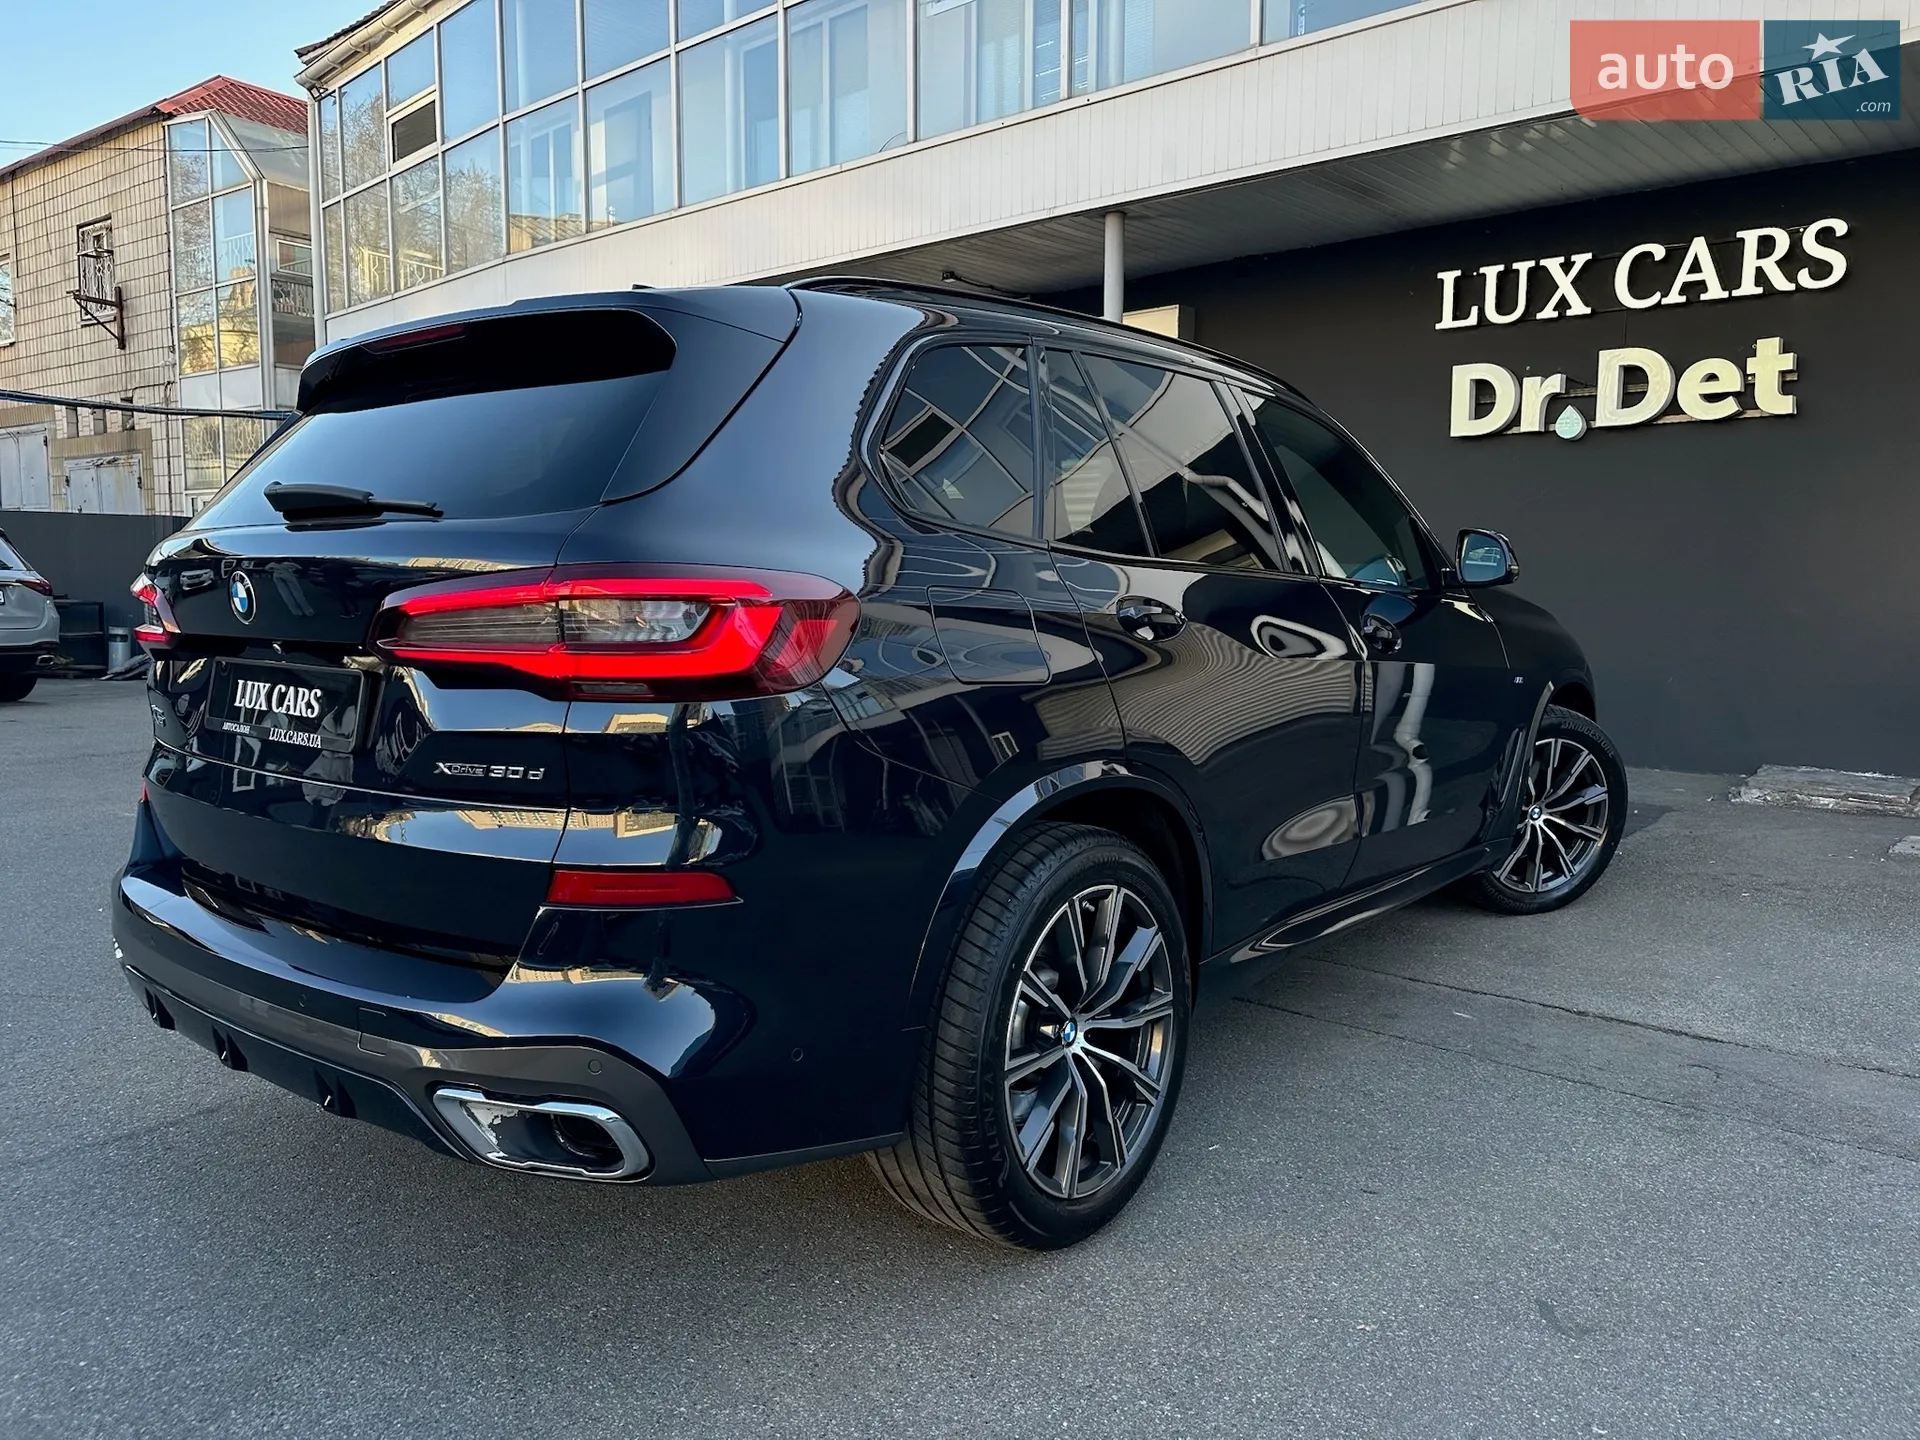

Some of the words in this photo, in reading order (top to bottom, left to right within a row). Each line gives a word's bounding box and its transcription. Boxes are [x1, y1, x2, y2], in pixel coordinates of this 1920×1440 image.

[1435, 252, 1594, 330] LUX
[1614, 217, 1849, 309] CARS
[234, 679, 271, 711] LUX
[271, 684, 322, 718] CARS
[982, 1072, 1003, 1162] ALENZA
